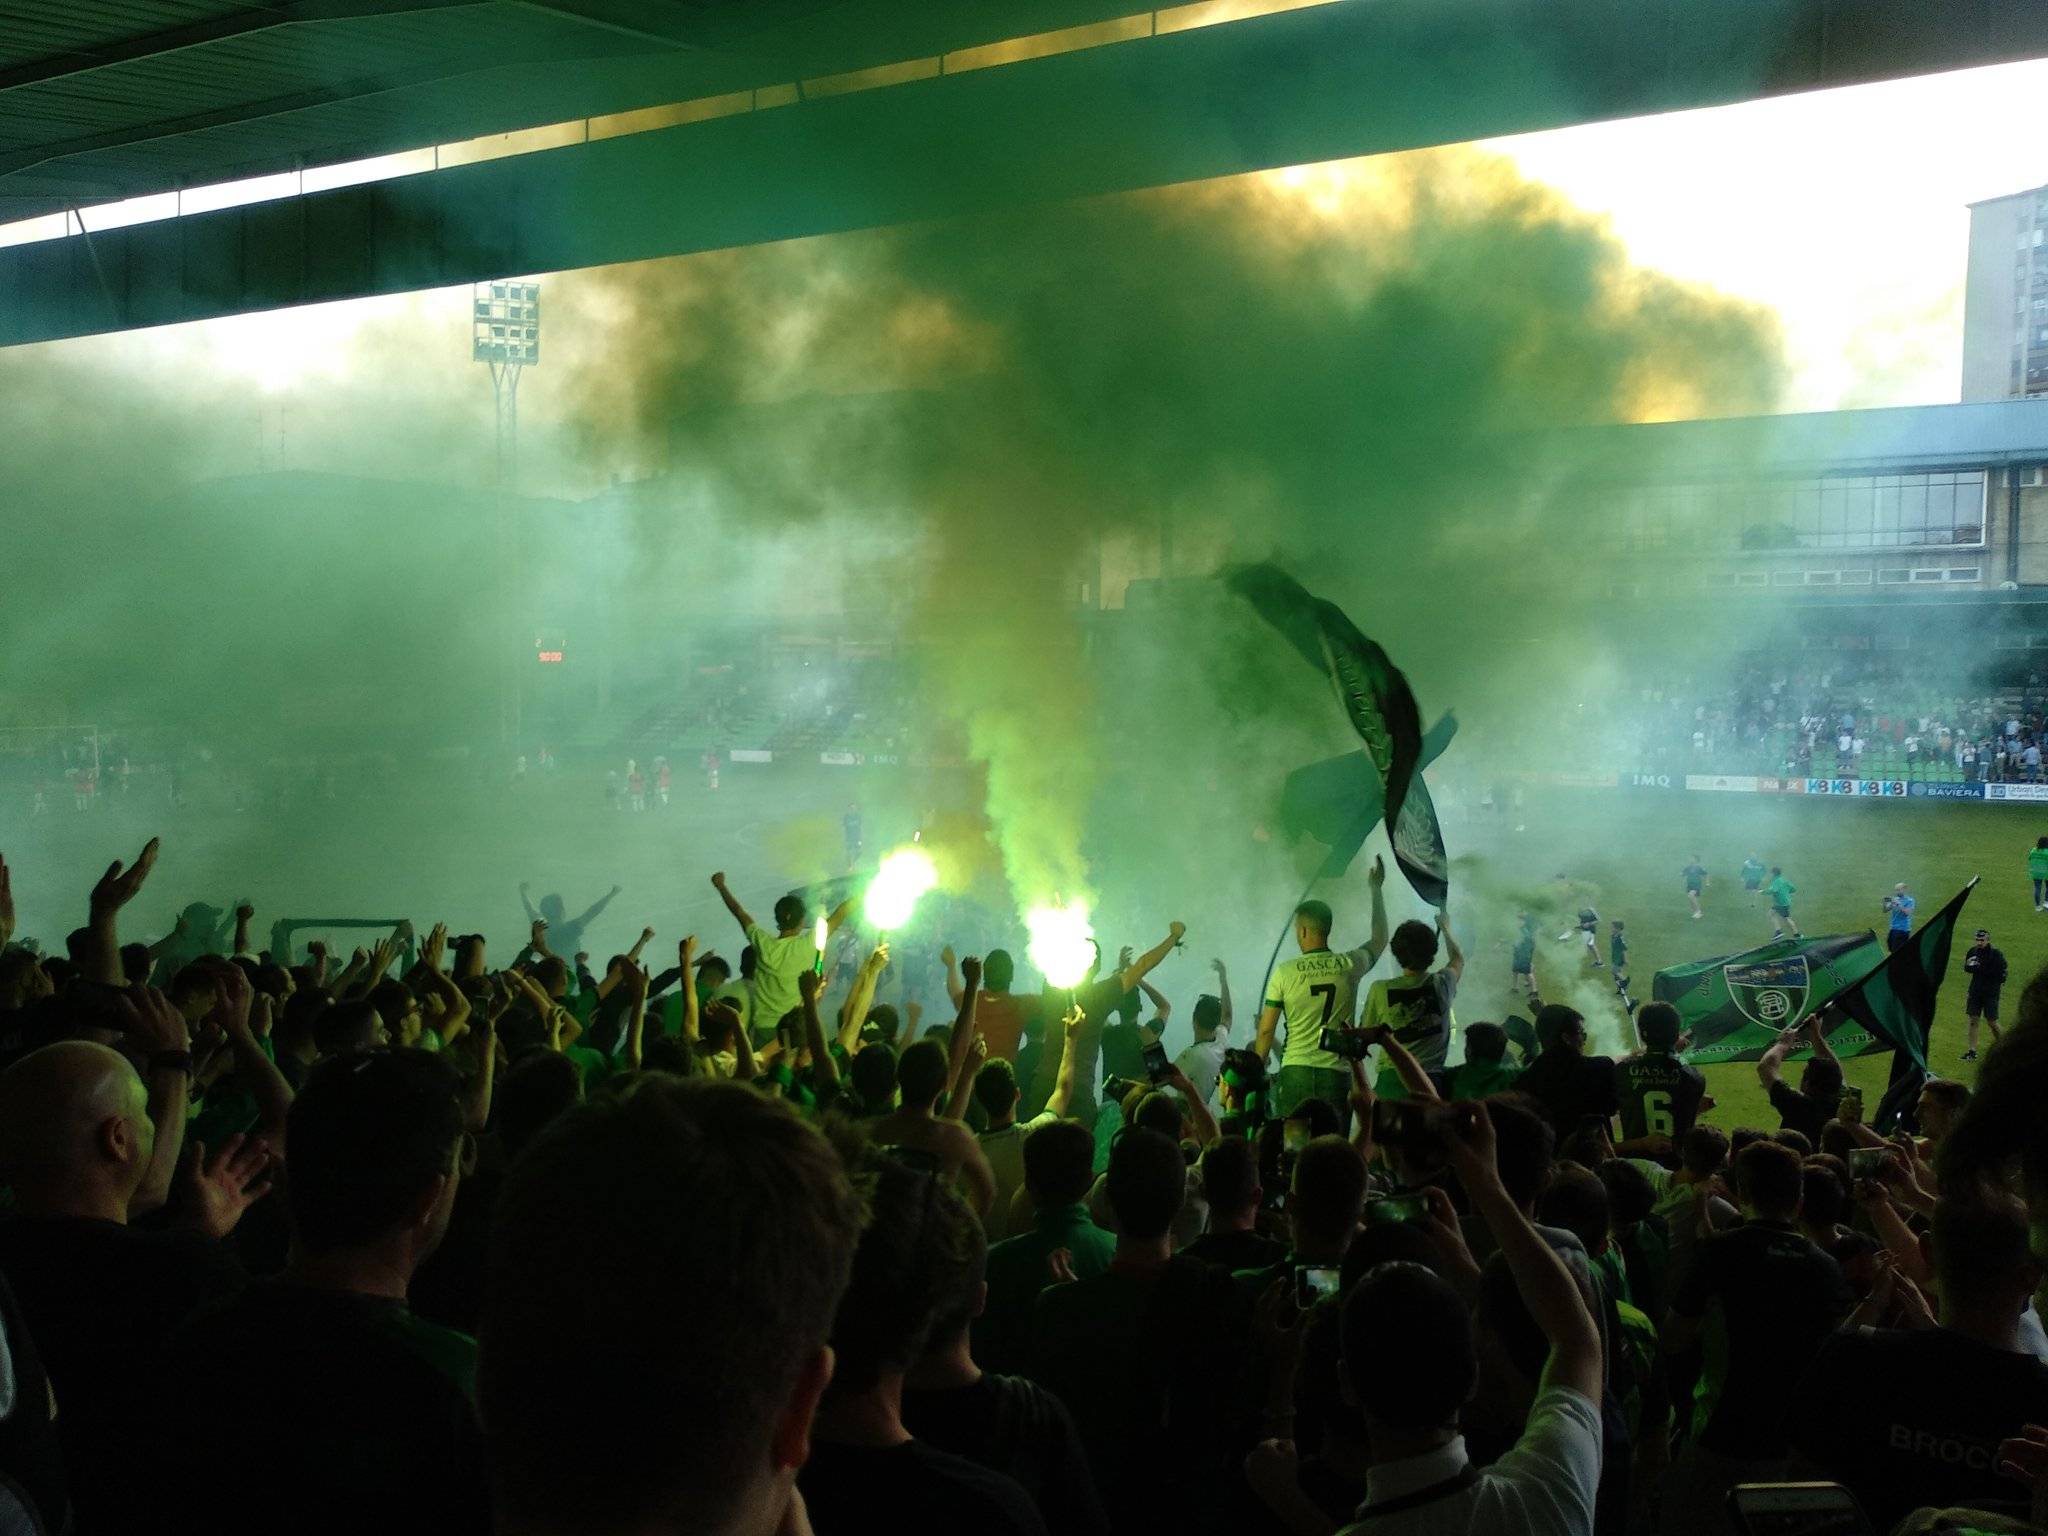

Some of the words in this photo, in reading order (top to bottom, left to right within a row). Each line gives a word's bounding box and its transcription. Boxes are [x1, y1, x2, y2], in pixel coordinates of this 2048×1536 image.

[1632, 774, 1671, 788] IMQ
[1927, 788, 1981, 797] BAVIERA
[1310, 983, 1336, 1026] 7
[1643, 1090, 1674, 1137] 6
